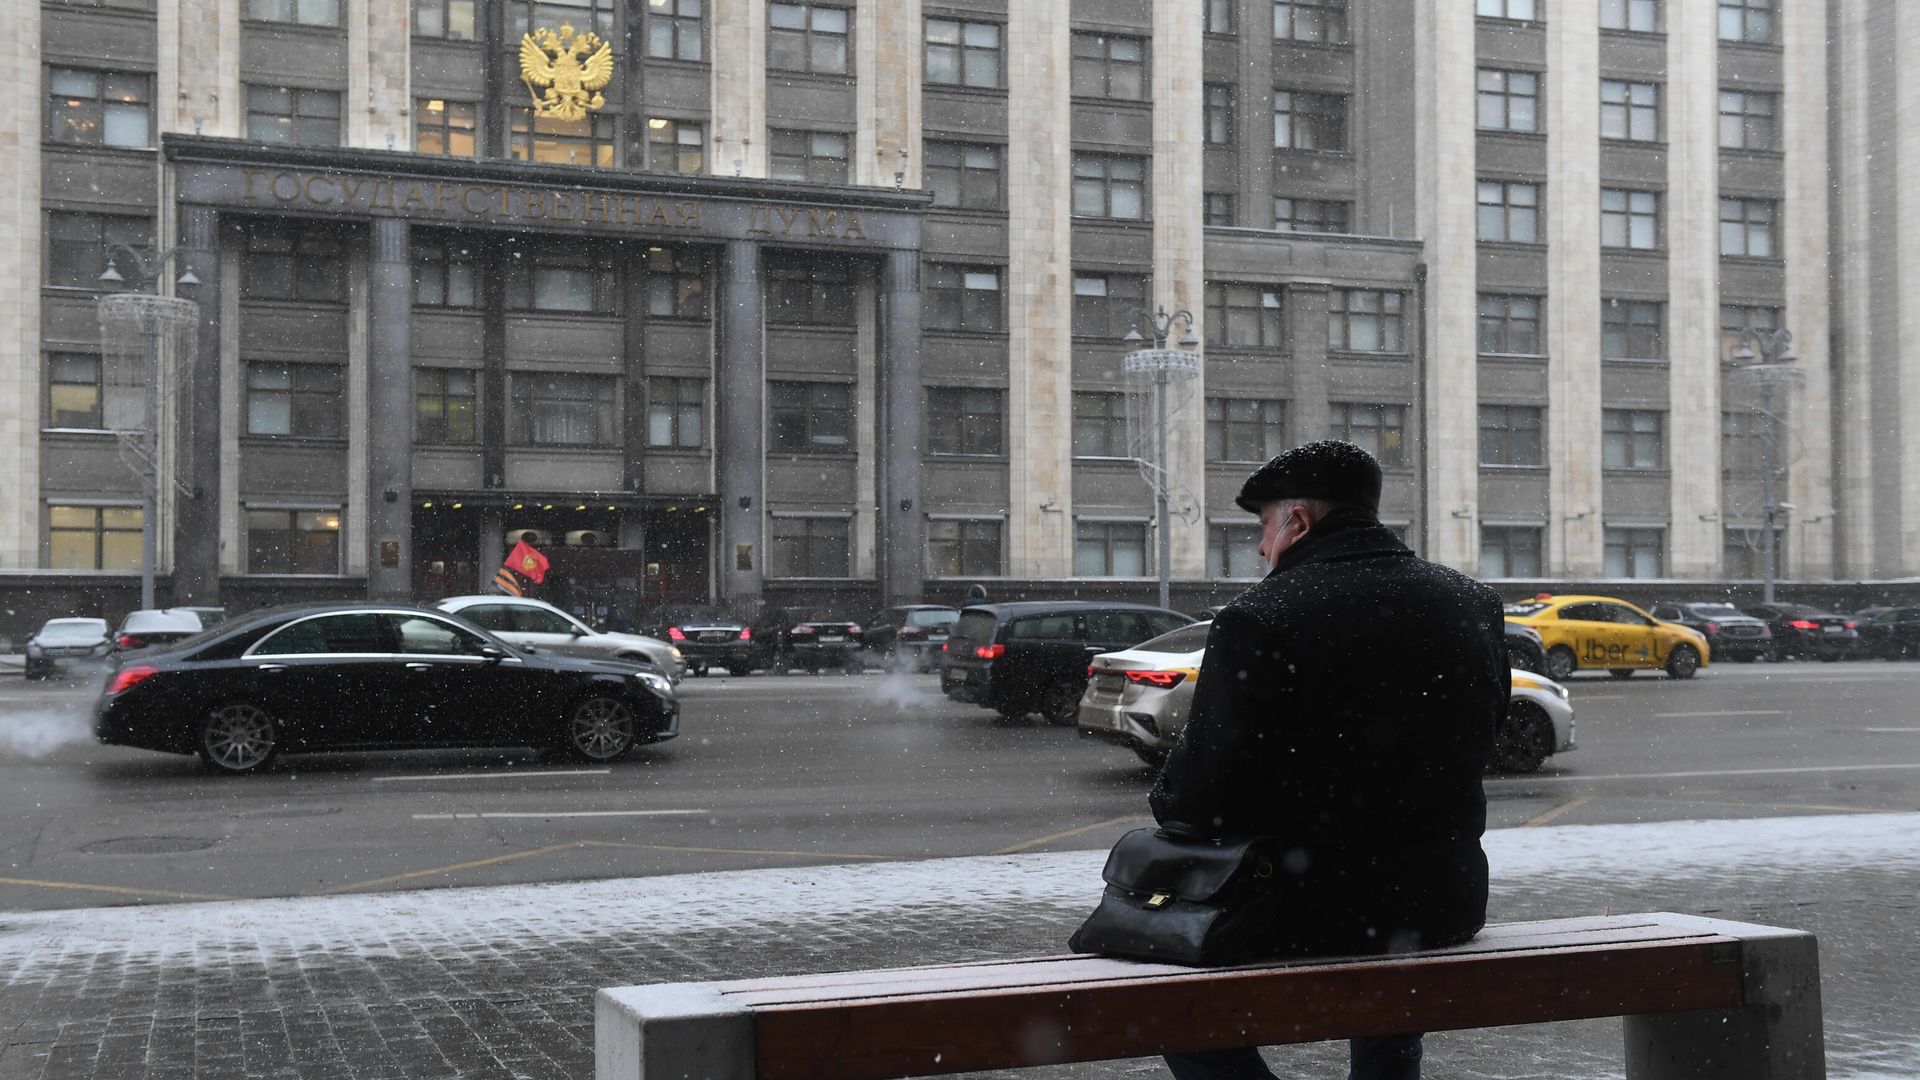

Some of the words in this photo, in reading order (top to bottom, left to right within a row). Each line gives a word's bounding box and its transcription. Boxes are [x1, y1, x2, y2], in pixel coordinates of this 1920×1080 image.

[244, 169, 701, 229] ГОСУДАРСТВЕННАЯ
[746, 204, 867, 240] ДУМА
[1575, 638, 1630, 661] Uber
